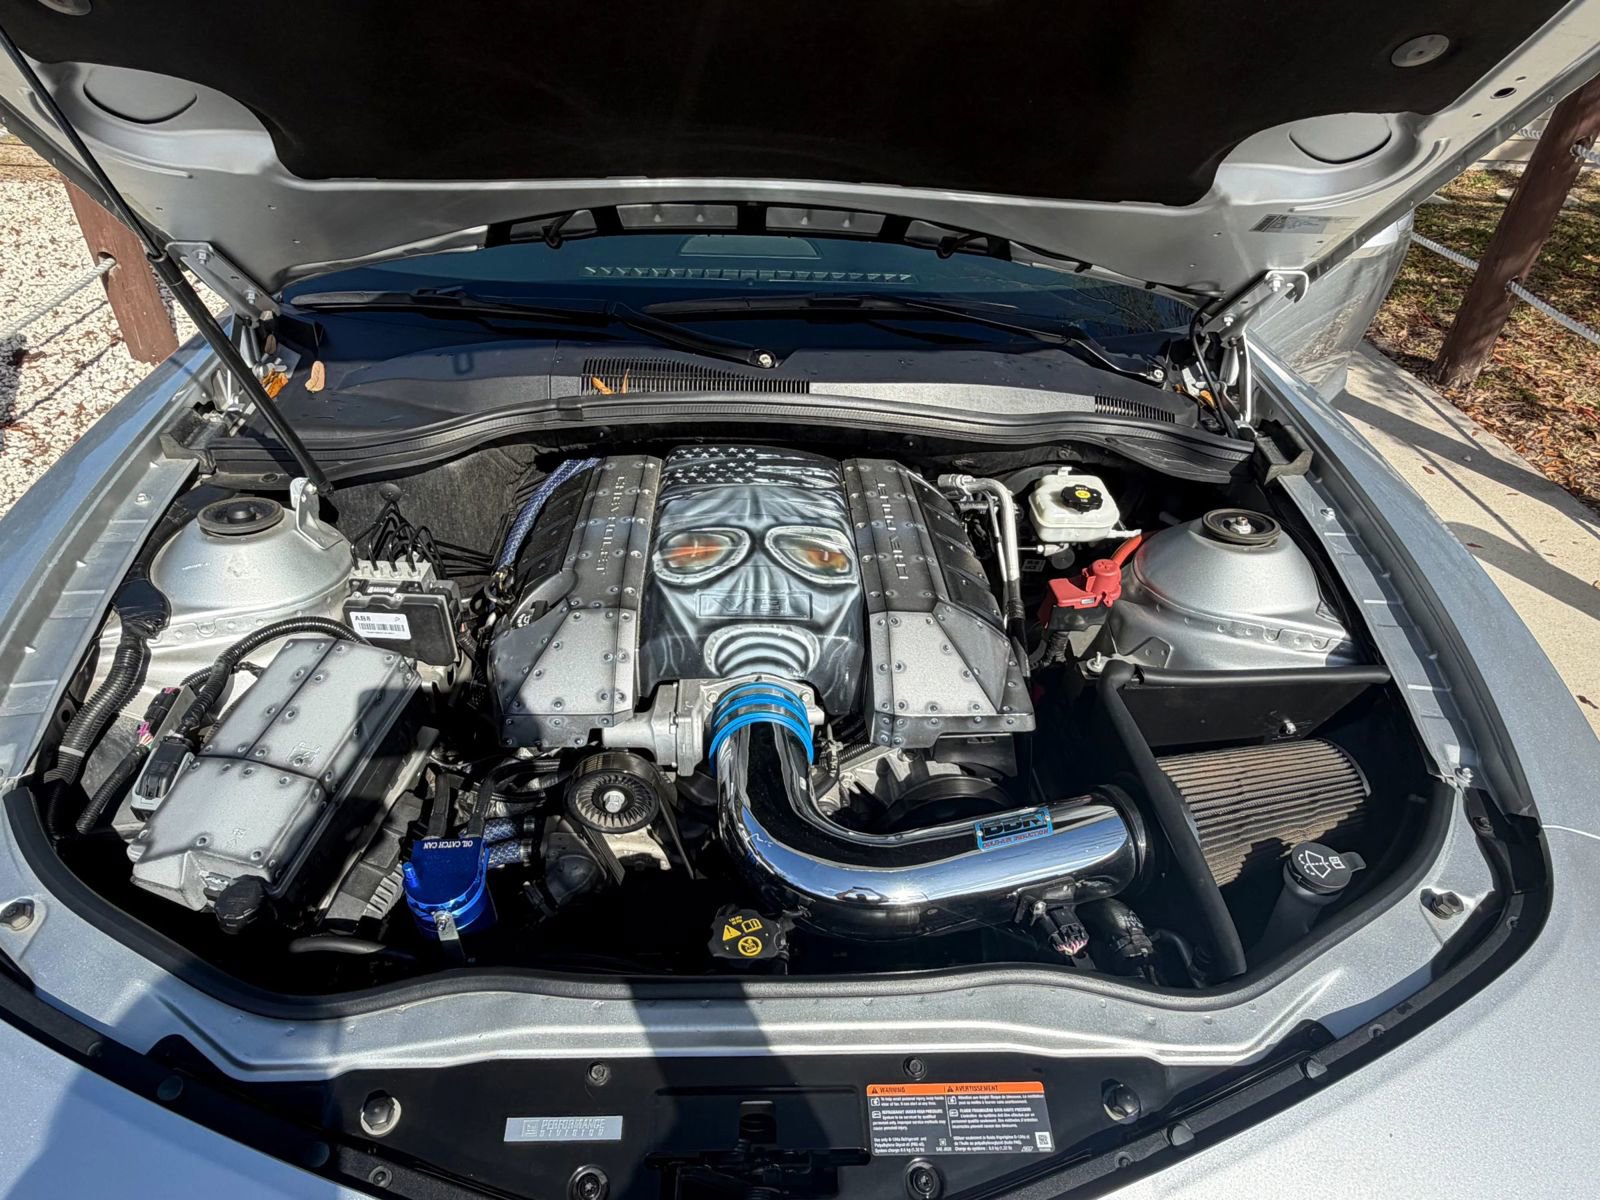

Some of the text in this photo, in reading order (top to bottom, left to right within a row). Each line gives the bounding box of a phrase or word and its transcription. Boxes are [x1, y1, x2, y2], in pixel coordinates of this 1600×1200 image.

[875, 479, 909, 579] CHEVROLET
[423, 842, 437, 850] CAN
[438, 841, 461, 849] CATCH
[955, 1084, 998, 1092] AVERTISSEMENT
[541, 1118, 606, 1130] PERFORMANCE
